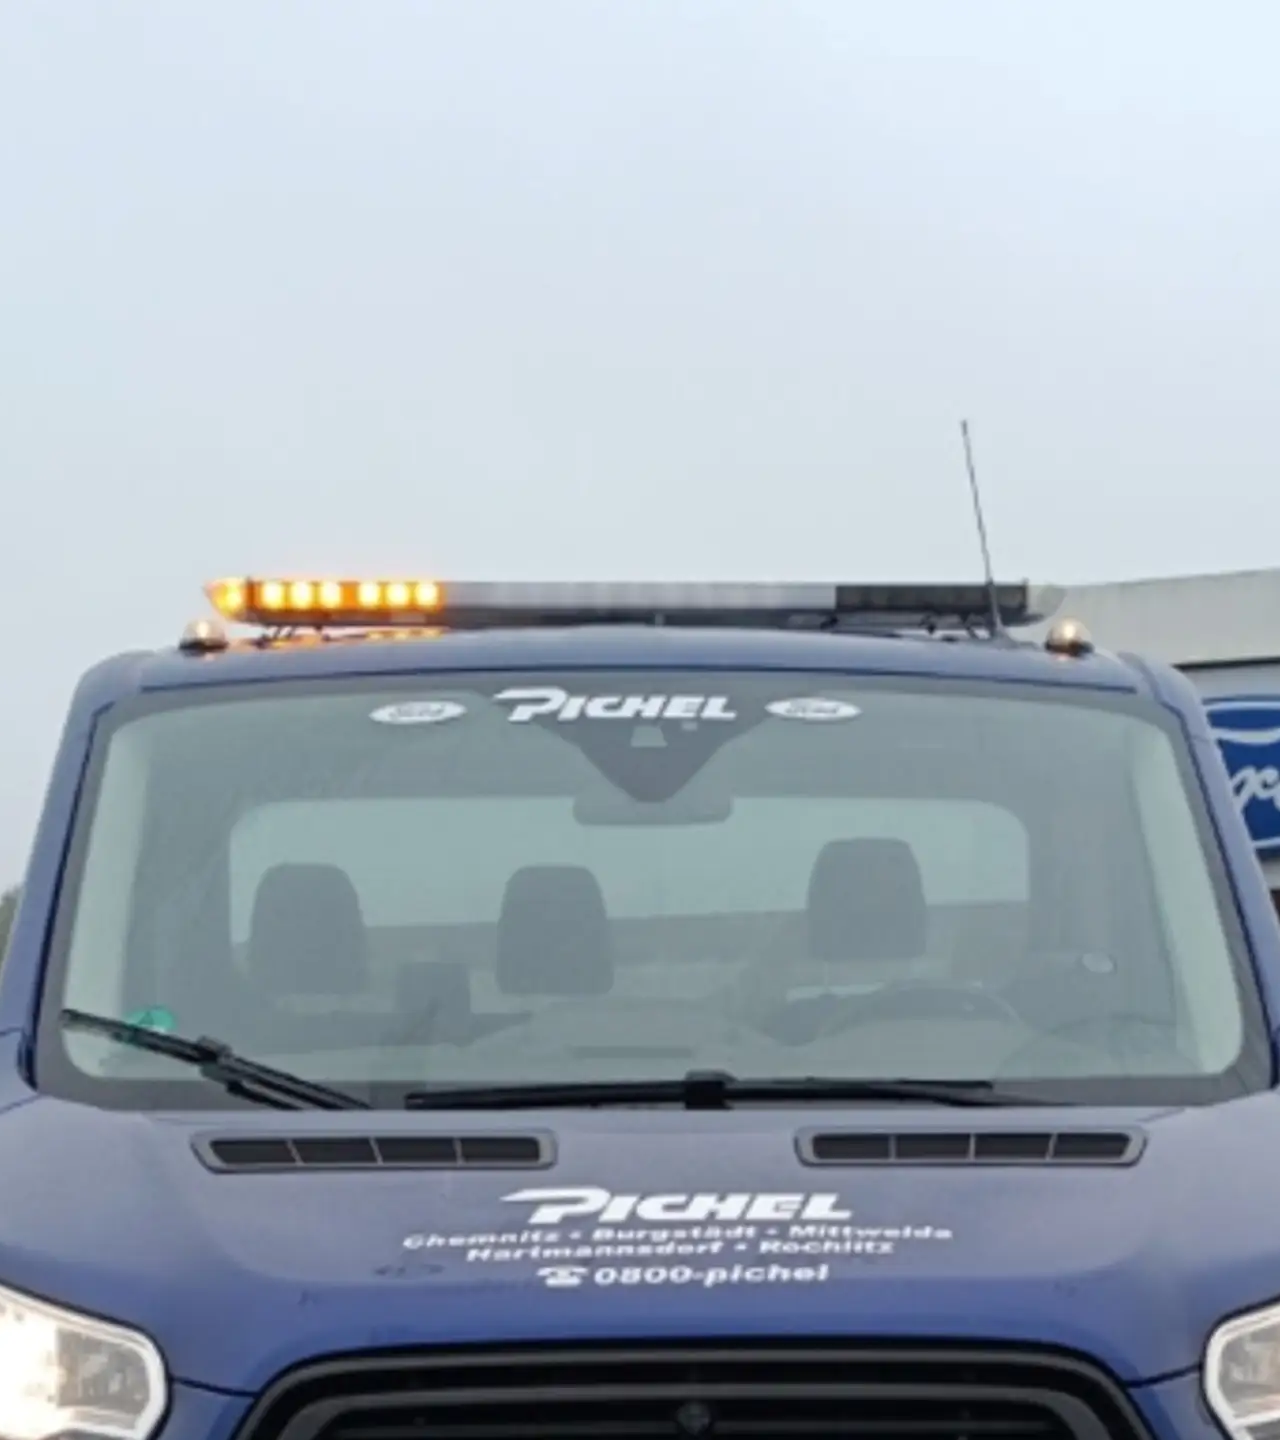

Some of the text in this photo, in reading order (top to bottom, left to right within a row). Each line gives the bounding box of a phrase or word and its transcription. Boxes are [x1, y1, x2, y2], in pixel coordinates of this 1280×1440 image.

[493, 686, 737, 721] PICHEL
[499, 1188, 852, 1224] PICHEL
[402, 1224, 953, 1249] Chemnitz Burgstädt Mittweida
[466, 1239, 895, 1262] Hartmannsdorf Rochlitz
[593, 1263, 830, 1288] 0800-pichel
